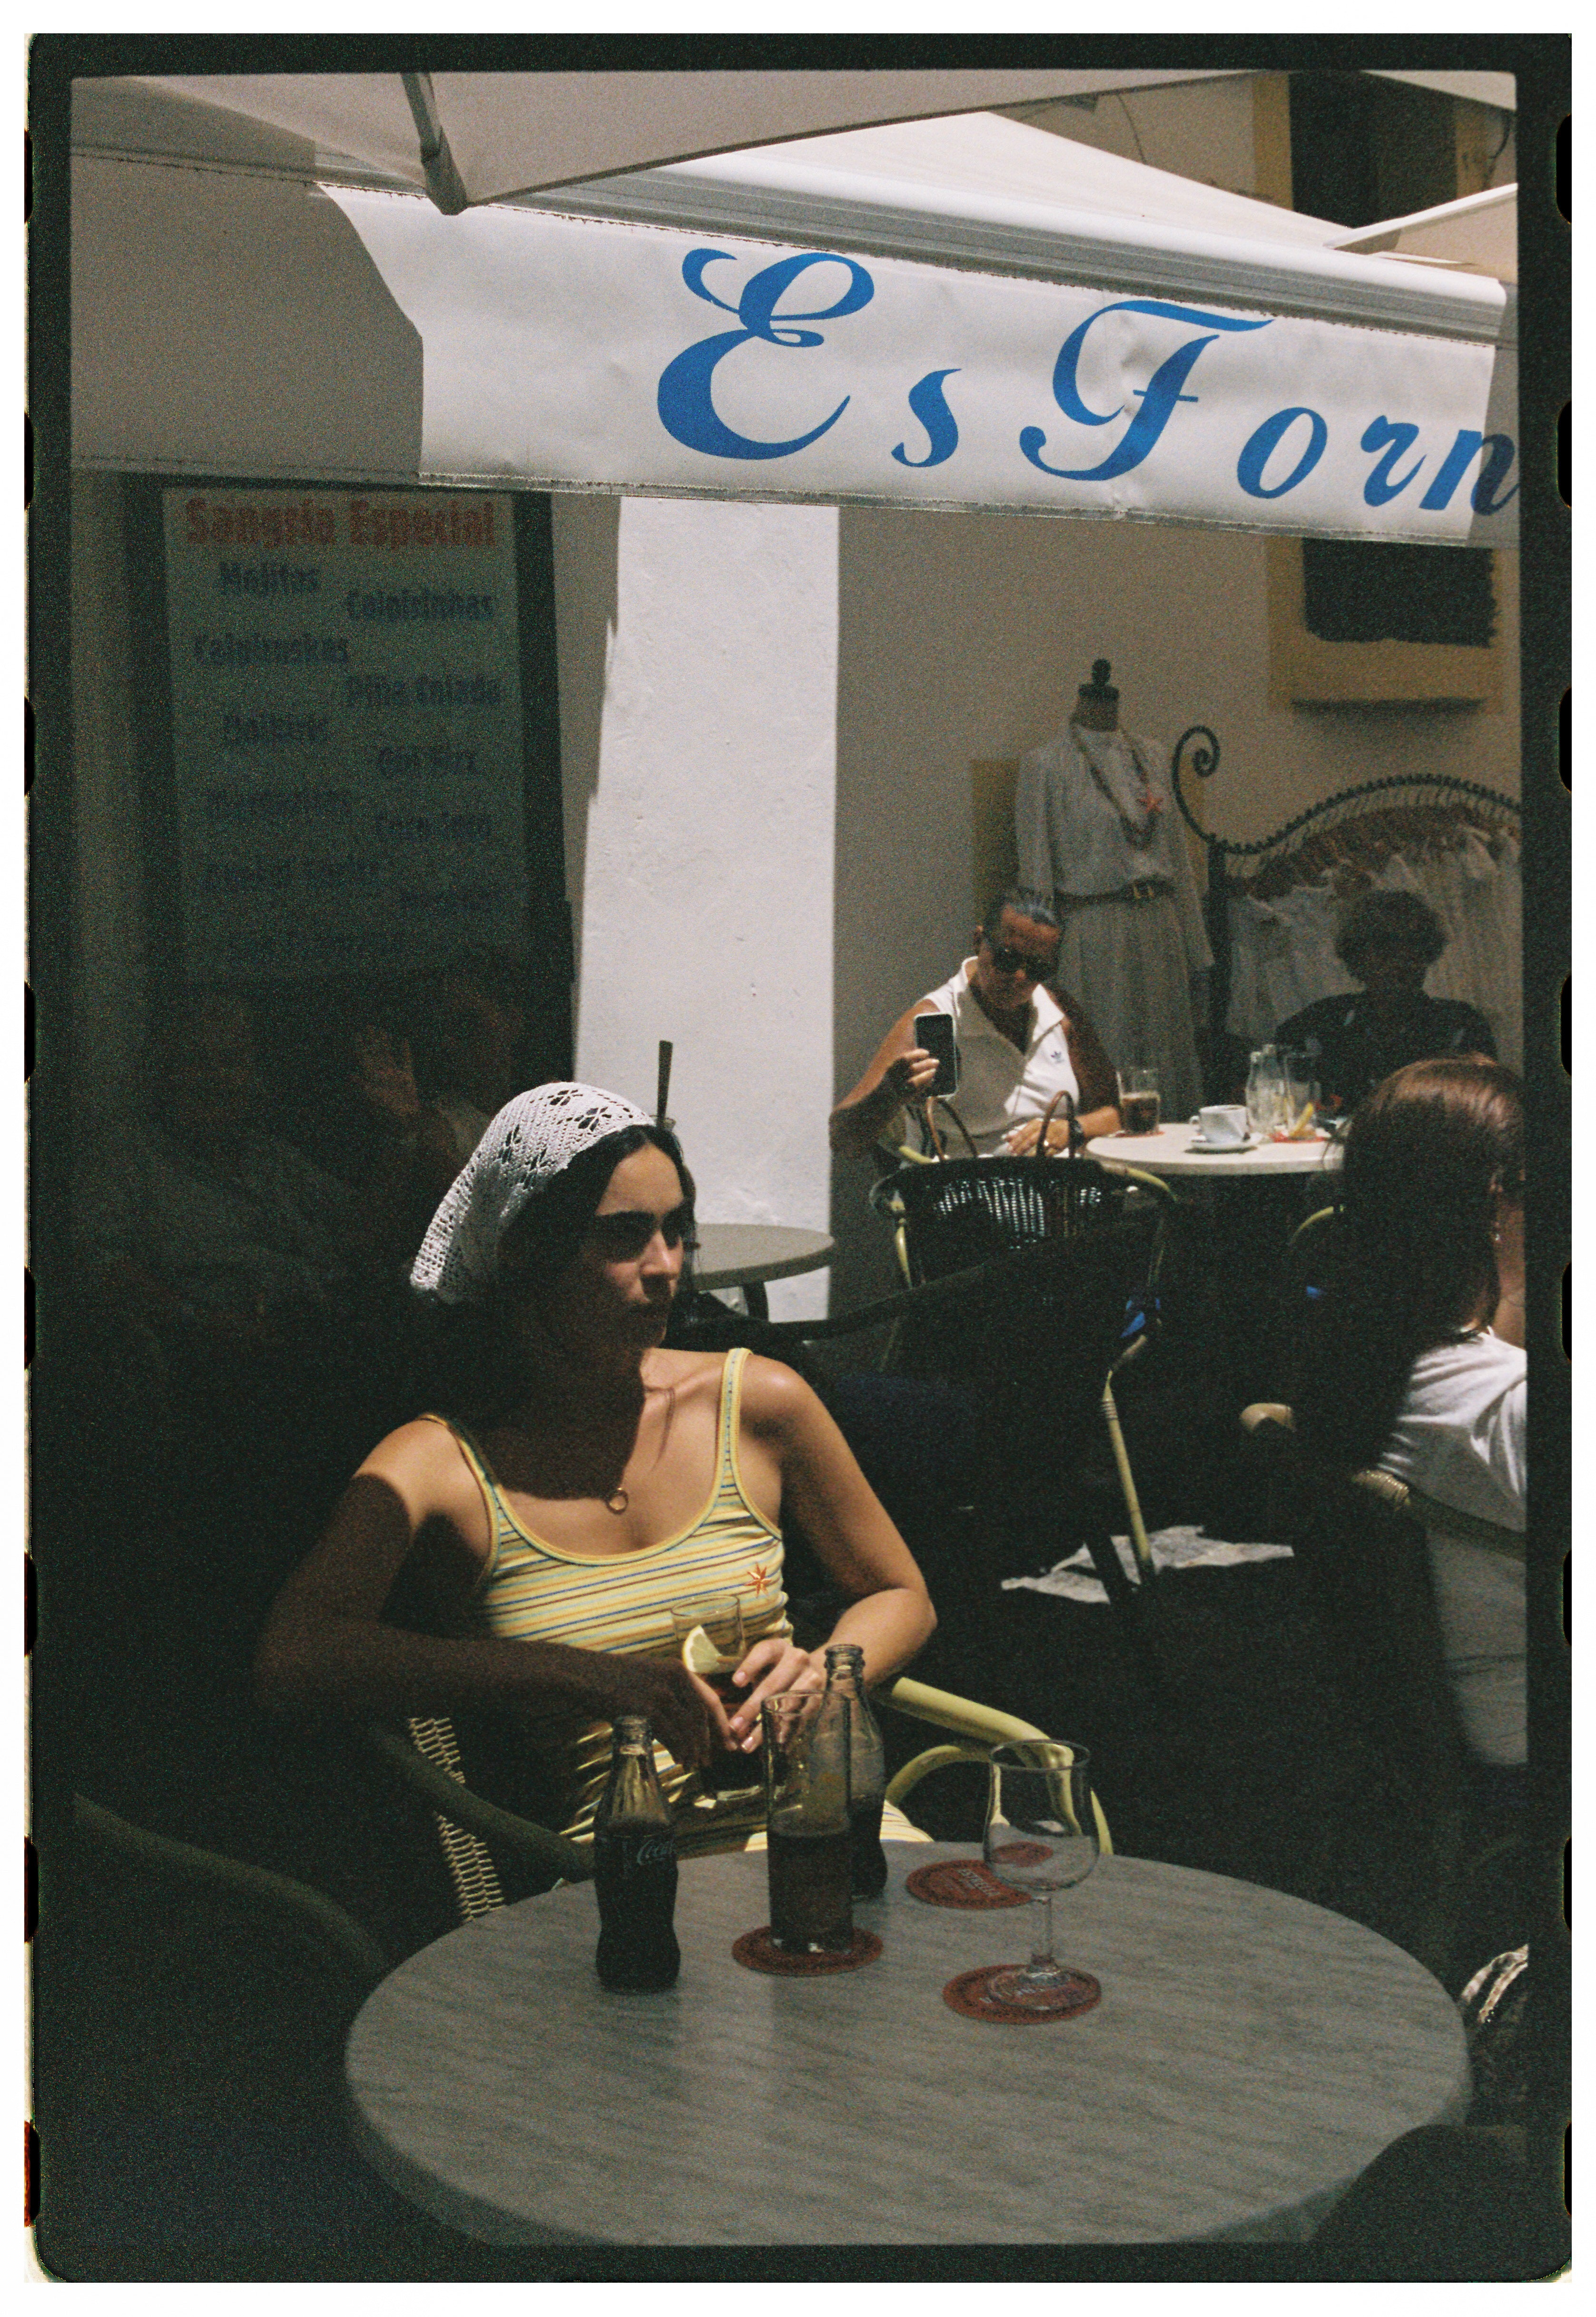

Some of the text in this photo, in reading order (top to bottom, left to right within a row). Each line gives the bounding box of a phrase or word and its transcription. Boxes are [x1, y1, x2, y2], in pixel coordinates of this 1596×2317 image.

[656, 248, 1521, 516] Es Forn
[349, 499, 496, 550] Especial
